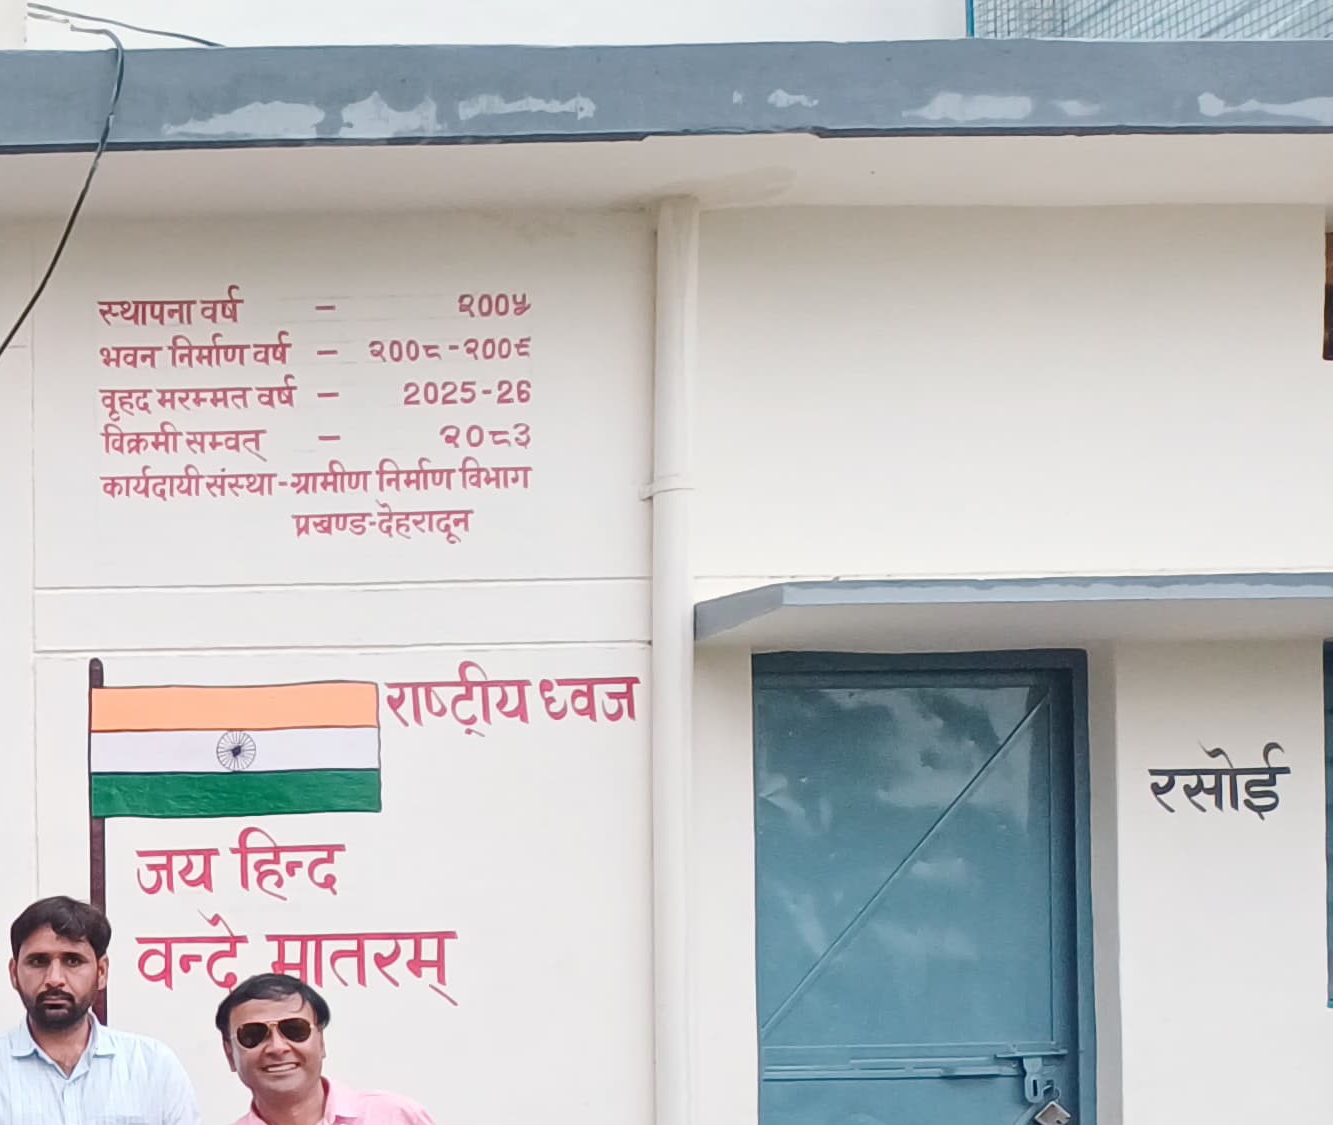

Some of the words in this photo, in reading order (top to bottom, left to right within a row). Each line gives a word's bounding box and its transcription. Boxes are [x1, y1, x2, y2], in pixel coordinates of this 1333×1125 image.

[98, 299, 196, 326] स्थापना
[200, 285, 244, 323] वर्ष
[99, 346, 163, 368] भवन
[168, 333, 251, 368] निर्माण
[253, 331, 292, 365] वर्ष
[99, 388, 153, 422] वृहद
[156, 386, 253, 410] मरम्मत
[255, 374, 298, 409] वर्ष
[403, 380, 532, 406] 2025-26
[100, 421, 183, 454] विक्रमी
[185, 429, 267, 463] सम्वत्
[439, 422, 531, 449] २०८३
[99, 464, 204, 502] कार्यदायी
[375, 457, 456, 493] निर्माण
[458, 455, 533, 489] विभाग
[385, 659, 532, 738] राष्ट्रीय
[538, 675, 641, 724] ध्वज
[1147, 741, 1291, 822] रसोई
[135, 847, 220, 896] जय
[230, 825, 347, 902] हिन्द
[135, 908, 249, 993] वन्दे
[265, 928, 458, 1007] मातरम्
